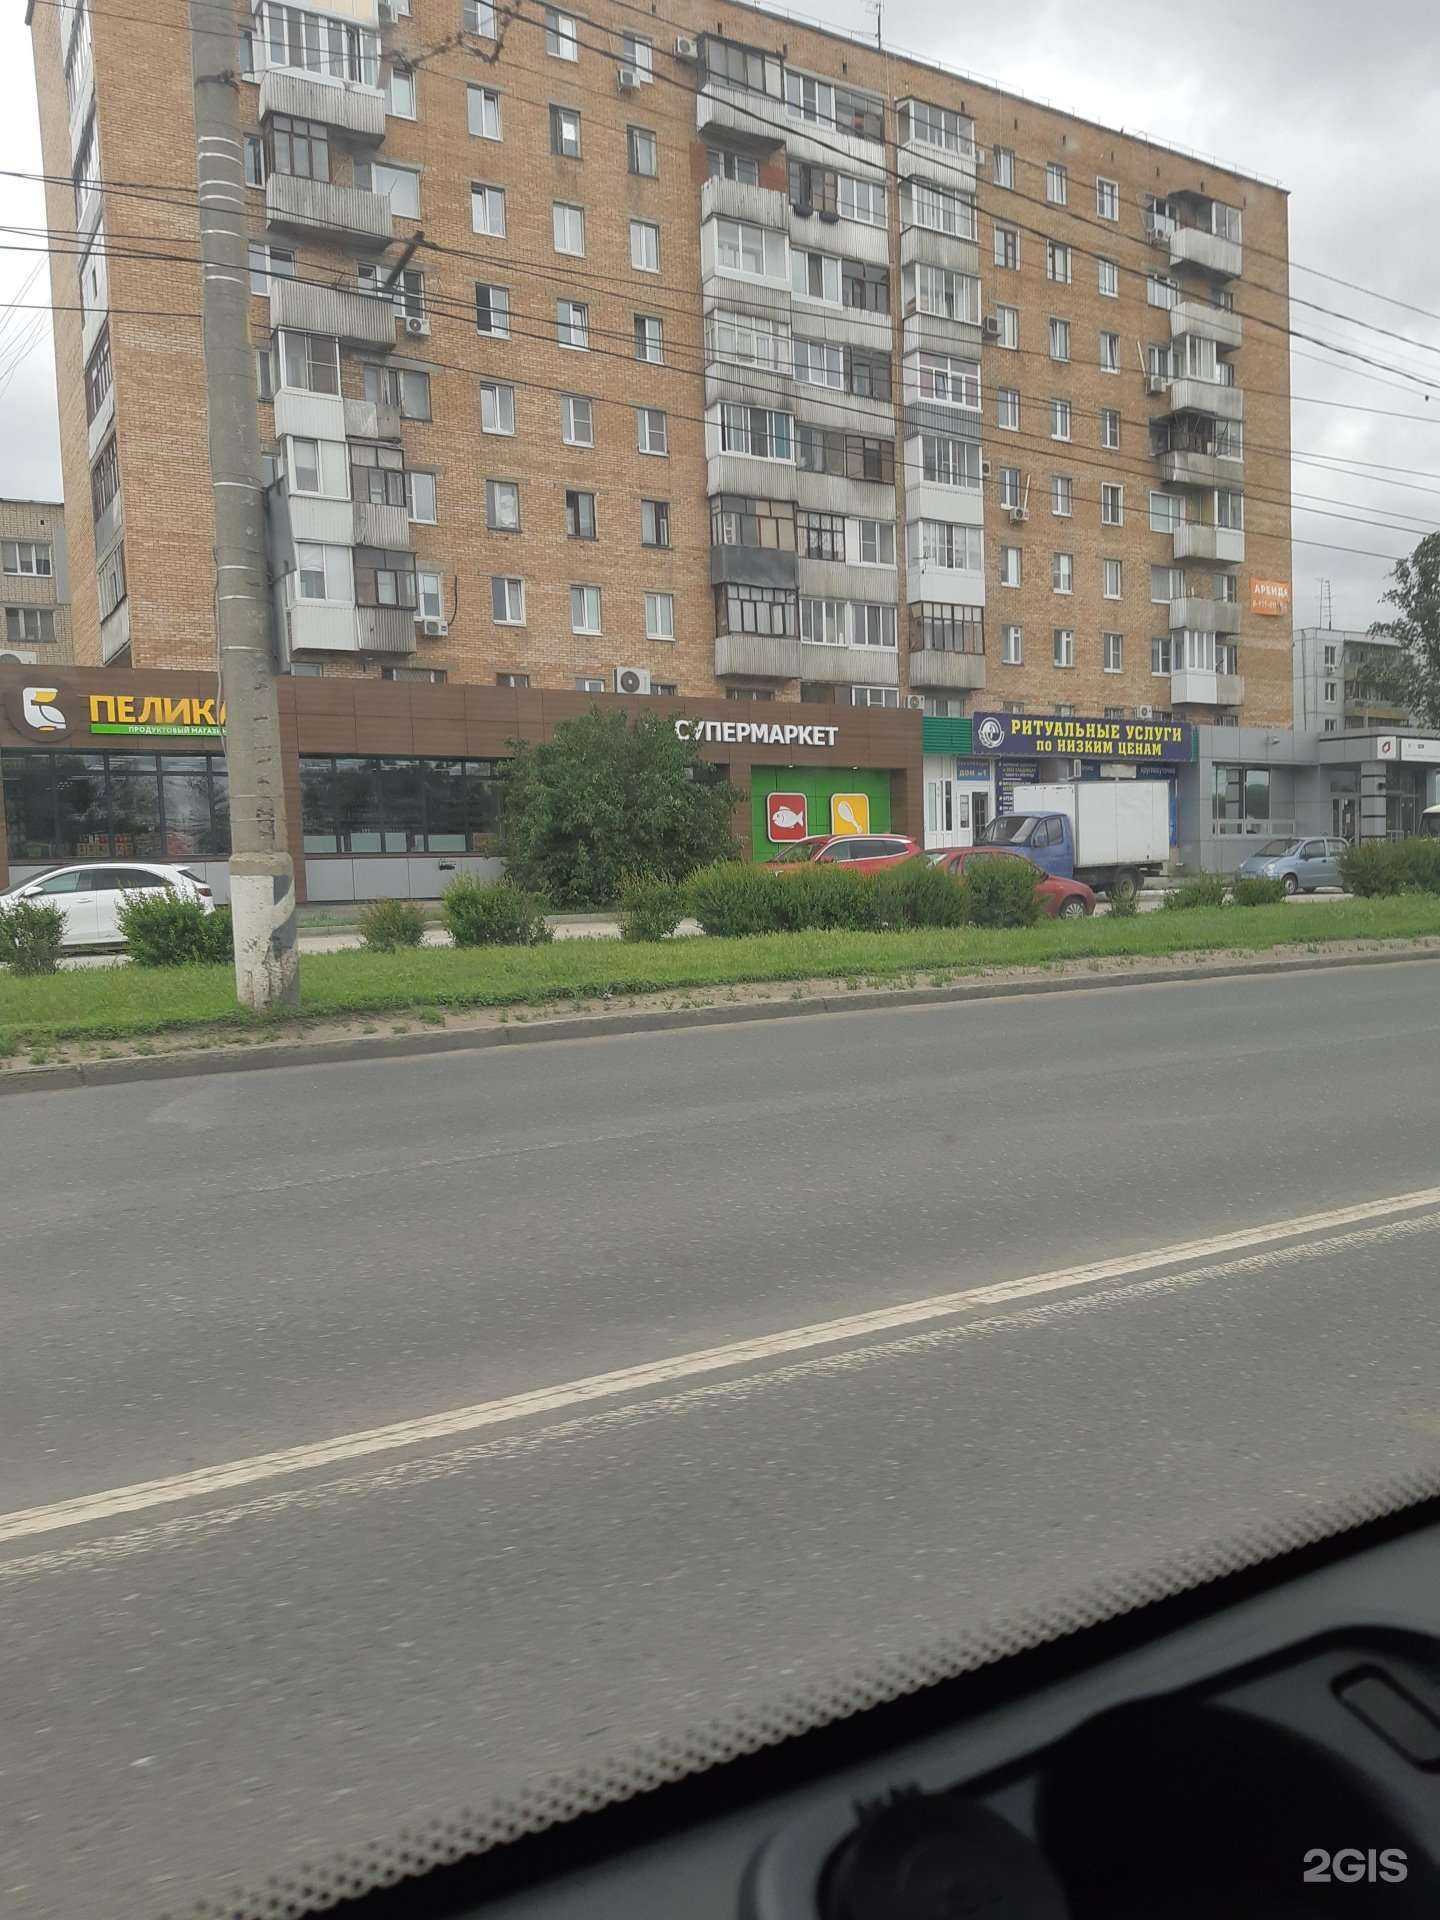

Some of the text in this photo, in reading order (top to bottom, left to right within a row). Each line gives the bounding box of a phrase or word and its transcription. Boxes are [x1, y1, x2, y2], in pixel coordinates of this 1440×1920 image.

[128, 725, 190, 735] ПРОДУКТОВЫЙ
[674, 719, 839, 746] СУПЕРМАРКЕТ
[1011, 719, 1182, 742] РИТУАЛЬНЫЕ УСЛУГИ
[1057, 739, 1113, 754] НИЗКИМ
[1118, 741, 1162, 757] ЦЕНАМ
